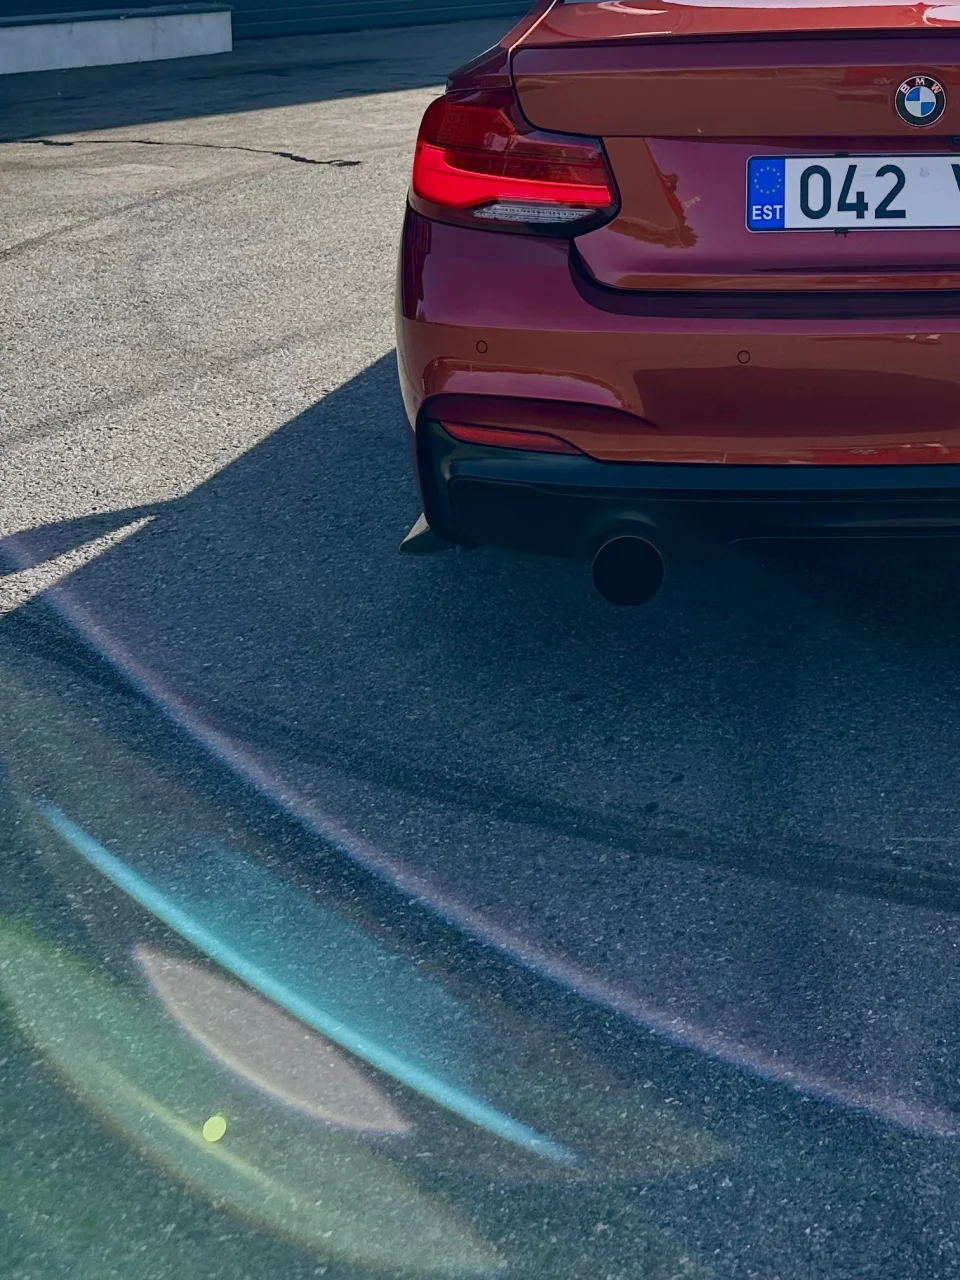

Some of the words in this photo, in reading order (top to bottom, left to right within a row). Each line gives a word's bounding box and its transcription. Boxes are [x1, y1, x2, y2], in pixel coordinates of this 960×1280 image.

[900, 77, 942, 94] BMW
[799, 164, 907, 220] 042
[752, 204, 784, 221] EST
